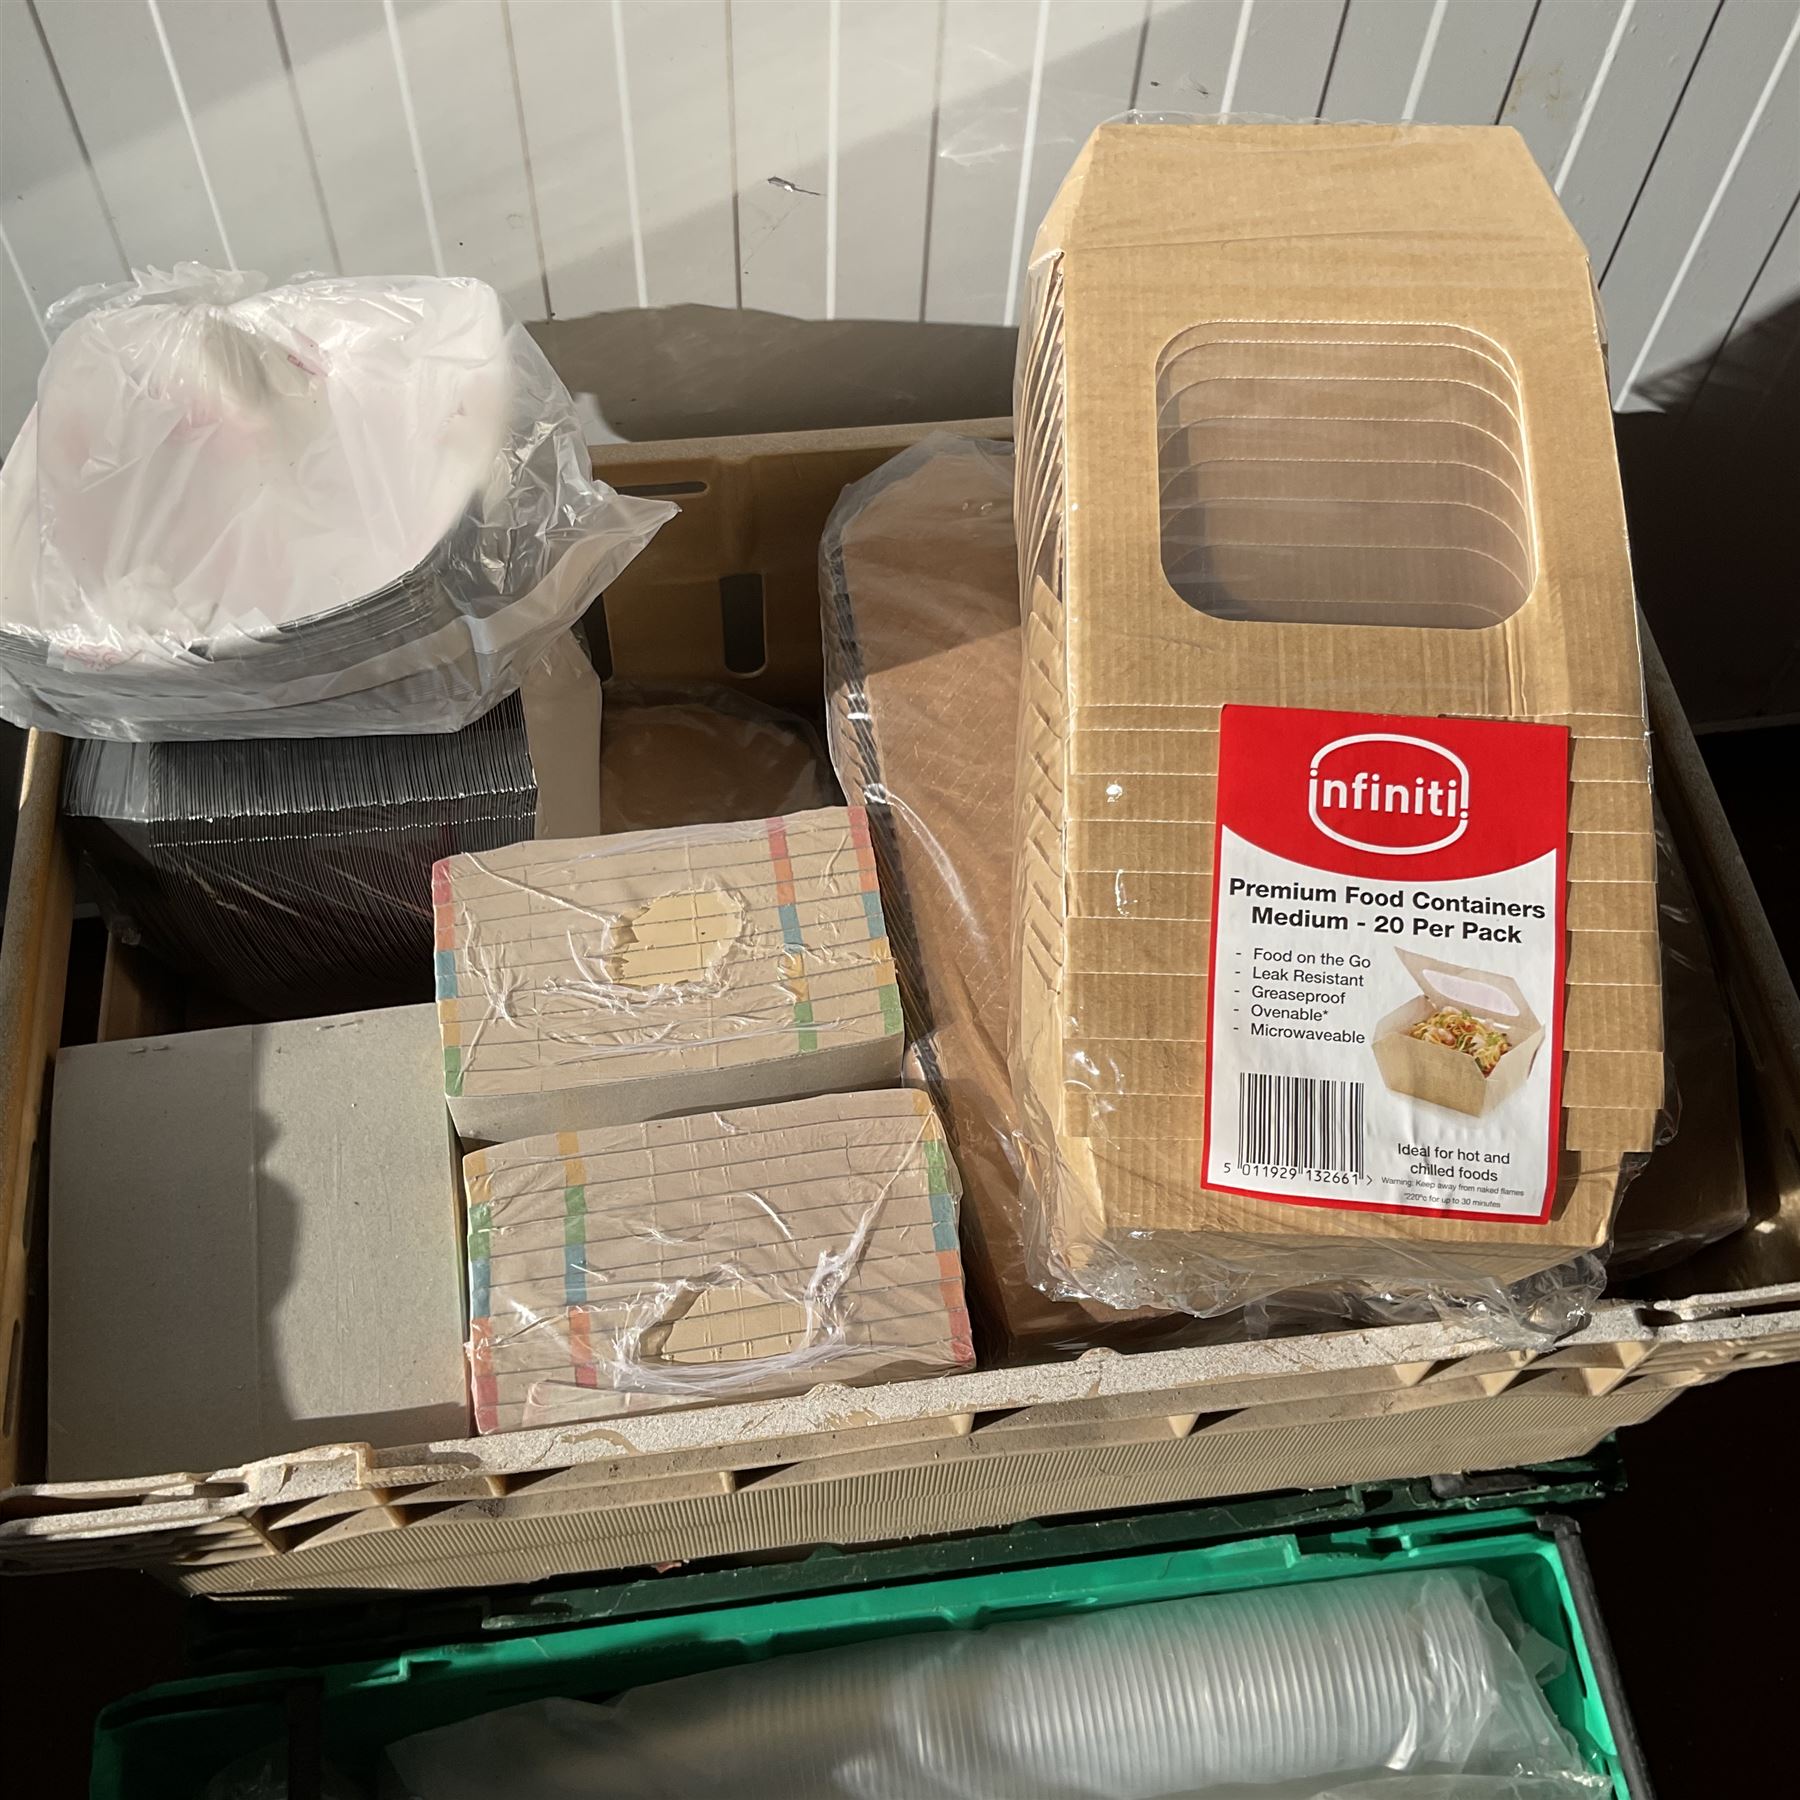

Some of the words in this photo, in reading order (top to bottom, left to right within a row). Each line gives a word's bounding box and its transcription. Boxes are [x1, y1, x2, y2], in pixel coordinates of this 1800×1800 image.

[1229, 877, 1337, 903] Premium
[1345, 886, 1404, 908] Food
[1412, 891, 1546, 919] Containers
[1251, 906, 1348, 930] Medium
[1374, 915, 1404, 934] 20
[1413, 918, 1454, 938] Per
[1462, 922, 1522, 944] Pack
[1253, 947, 1292, 963] Food
[1296, 953, 1316, 964] on
[1320, 953, 1344, 966] the
[1349, 954, 1371, 968] Go
[1252, 966, 1288, 981] Leak
[1293, 969, 1364, 987] Resistant
[1251, 985, 1346, 1004] Greaseproof
[1250, 1023, 1365, 1043] Microwaveable
[1397, 1143, 1430, 1157] Ideal
[1434, 1147, 1453, 1159] for
[1457, 1149, 1480, 1162] hot
[1484, 1153, 1510, 1164] and
[1223, 1162, 1231, 1174] 5
[1242, 1164, 1297, 1180] 011929
[1305, 1169, 1358, 1185] 132661
[1410, 1163, 1454, 1177] chilled
[1459, 1167, 1498, 1181] foods
[1381, 1177, 1414, 1187] Warning:
[1415, 1180, 1435, 1189] Keep
[1437, 1183, 1457, 1192] away
[1458, 1184, 1475, 1192] from
[1476, 1186, 1499, 1195] naked
[1500, 1188, 1524, 1197] flames
[1452, 1197, 1460, 1205] to
[1461, 1198, 1471, 1206] 30
[1473, 1200, 1501, 1208] minutes
